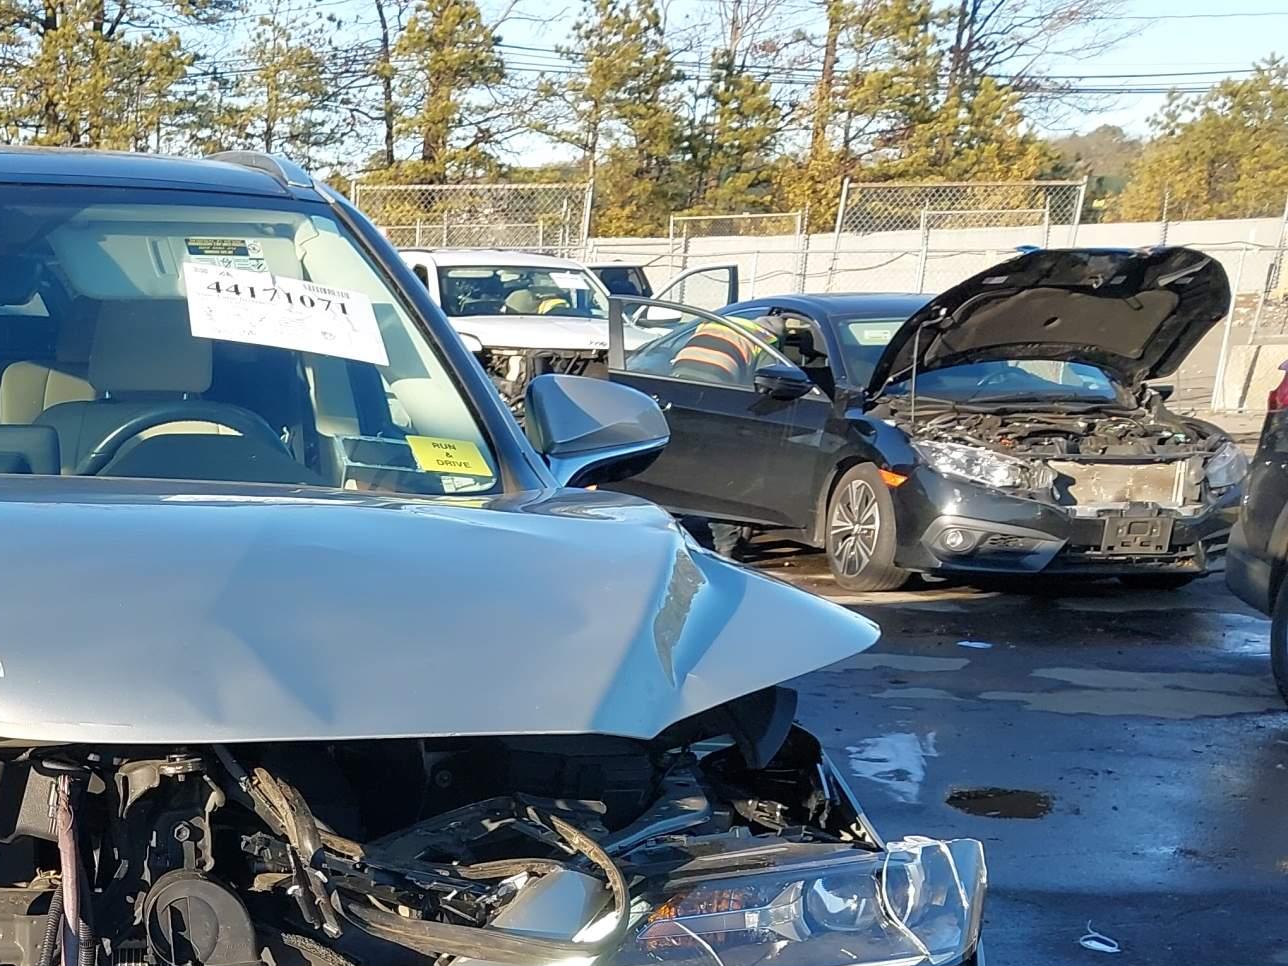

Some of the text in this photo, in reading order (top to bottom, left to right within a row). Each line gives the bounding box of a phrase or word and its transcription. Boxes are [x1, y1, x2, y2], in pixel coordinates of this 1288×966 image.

[206, 281, 349, 315] 44171071
[431, 441, 457, 451] RUN
[436, 459, 472, 469] DRIVE
